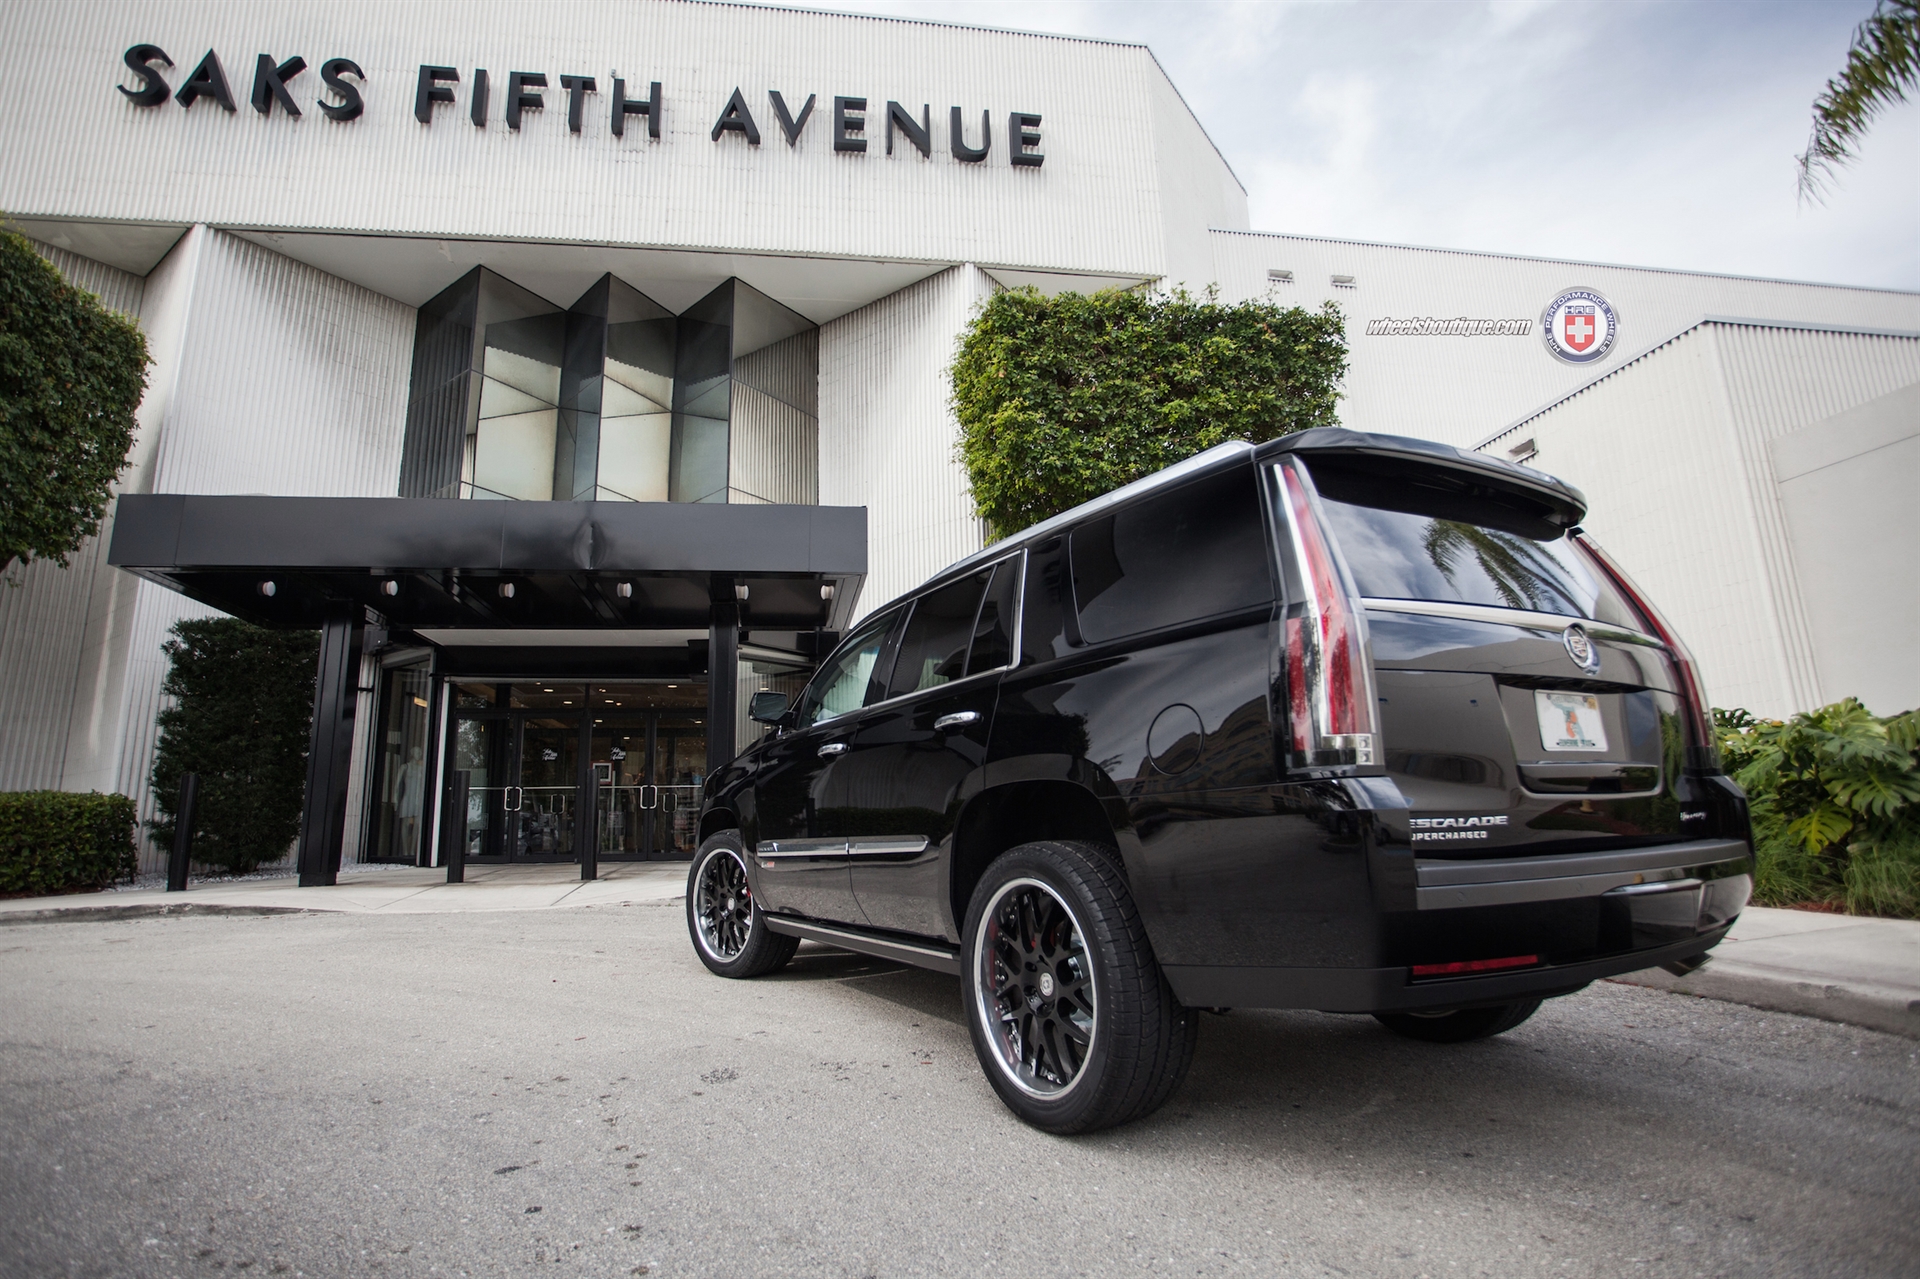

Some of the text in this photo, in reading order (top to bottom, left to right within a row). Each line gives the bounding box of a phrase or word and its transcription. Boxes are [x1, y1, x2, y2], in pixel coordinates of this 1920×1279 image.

[117, 44, 1045, 168] SAKS FIFTH AVENUE
[1411, 830, 1488, 841] PERCHARGED
